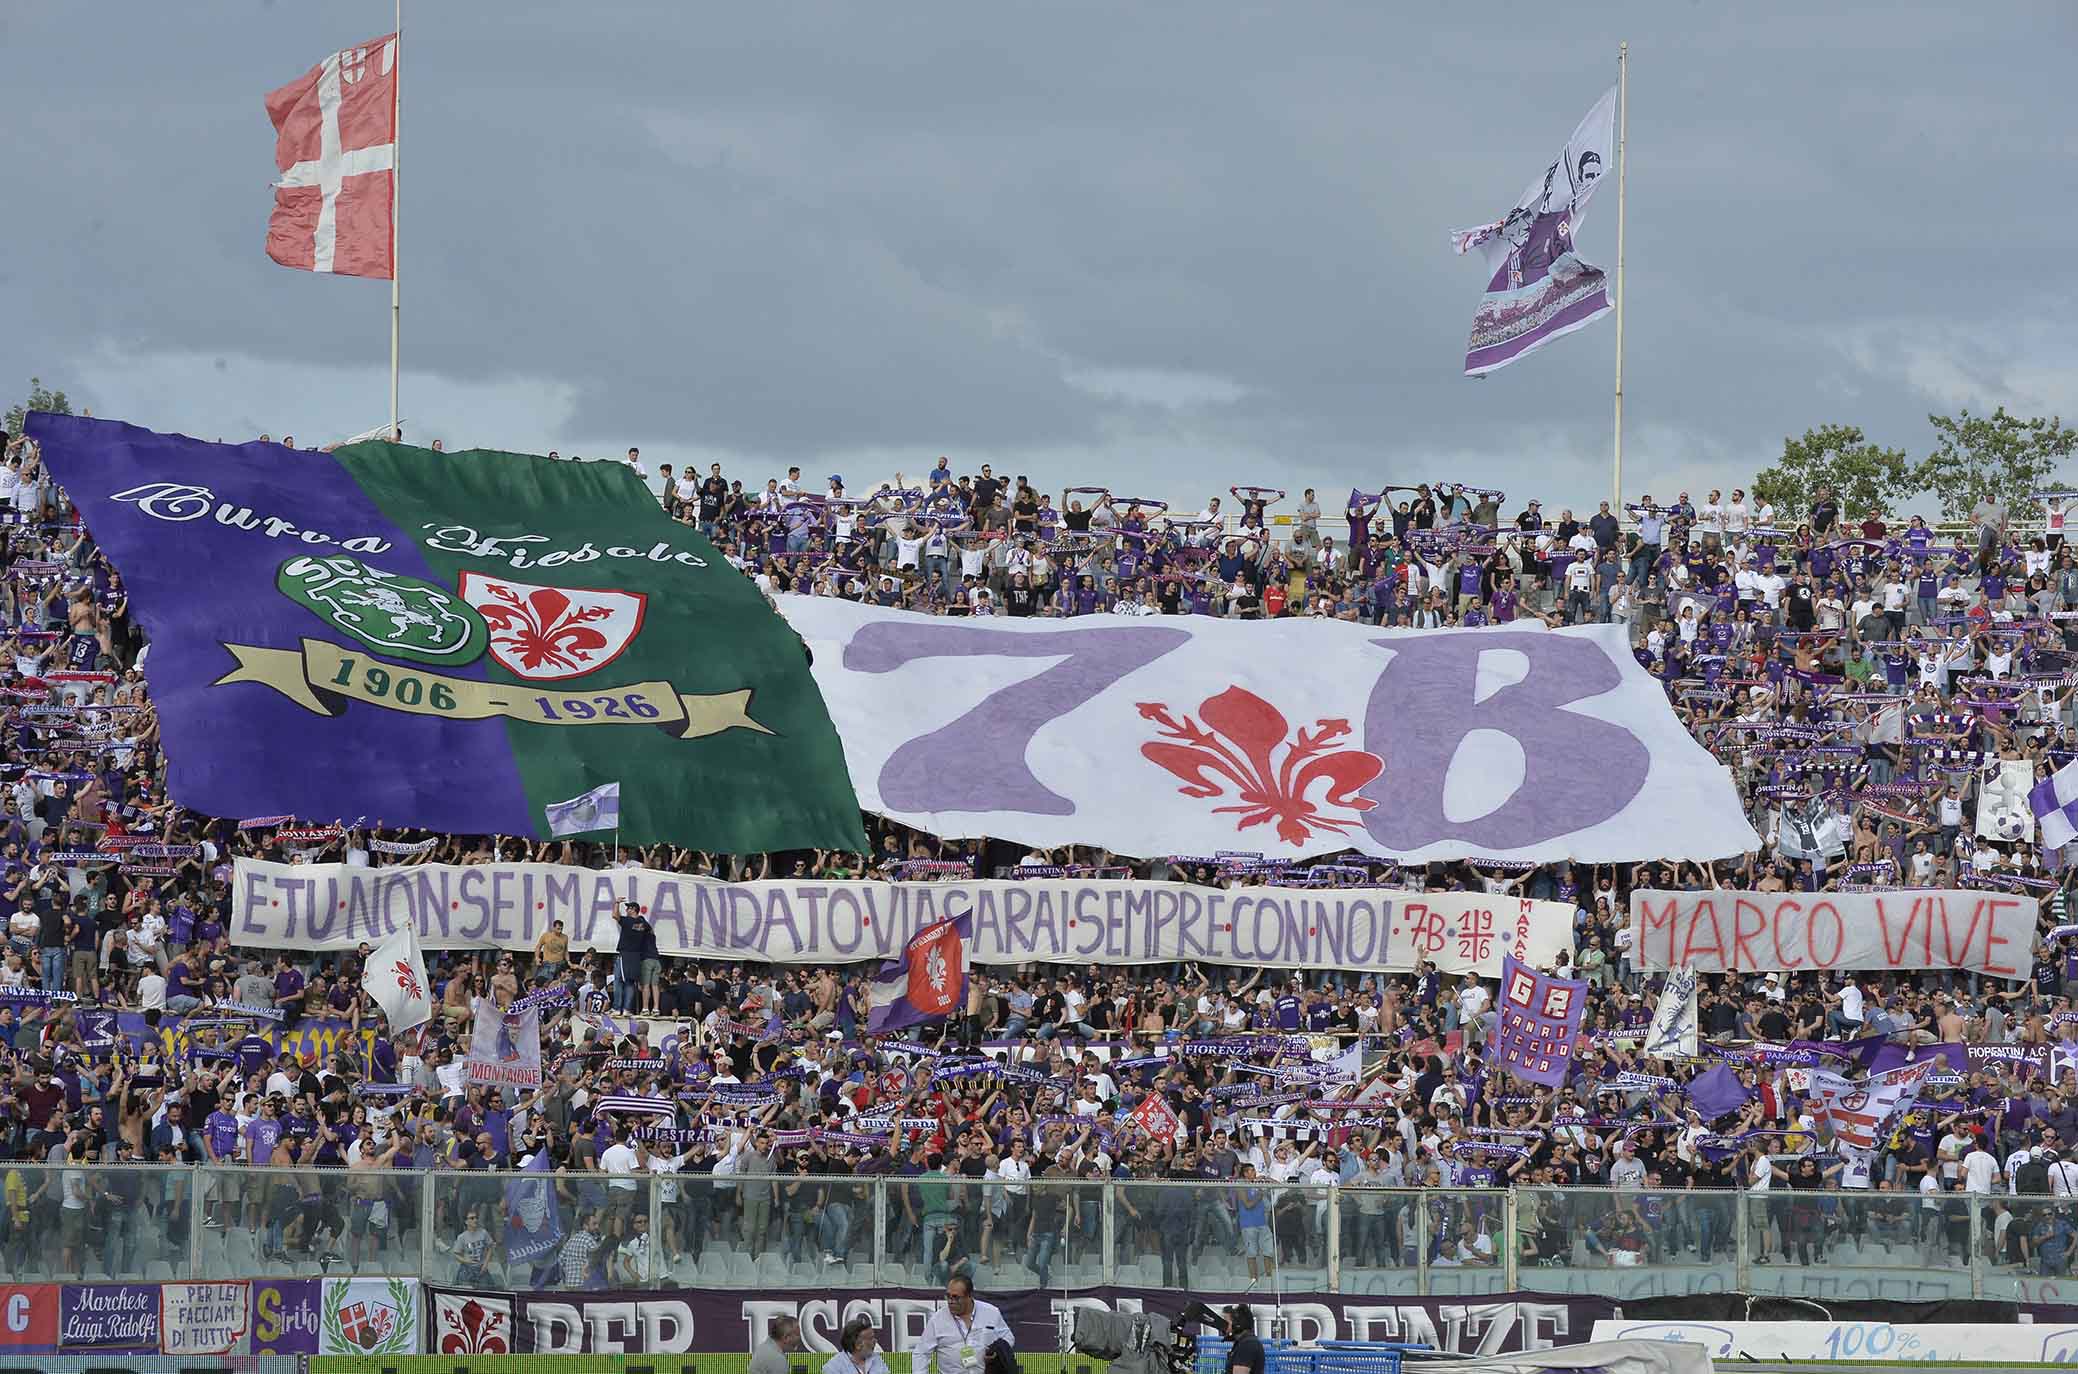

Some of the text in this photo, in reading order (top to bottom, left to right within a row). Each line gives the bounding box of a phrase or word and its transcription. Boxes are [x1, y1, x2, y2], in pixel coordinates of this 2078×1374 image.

[109, 481, 711, 570] Curva Fiesole
[330, 658, 457, 712] 1906
[534, 690, 660, 723] 1926
[842, 621, 1651, 850] 7 B
[1019, 866, 1066, 875] FIORENTINA
[275, 876, 346, 940] TU
[346, 871, 450, 941] NON
[459, 870, 534, 941] SEI
[648, 881, 864, 954] ANDATO
[1074, 888, 1225, 958] SEMPRE
[1231, 895, 1308, 963] CON
[1315, 899, 1393, 965] NOI
[1404, 903, 1446, 952] 7B
[1511, 900, 1534, 962] MARAS
[1638, 897, 2020, 975] MARCO VIVE
[611, 1059, 665, 1070] COLLETTIVO
[1765, 1051, 1812, 1062] PAMPERO
[72, 1287, 149, 1312] Marchese
[187, 1286, 212, 1303] PER
[218, 1286, 238, 1302] LEI
[7, 1293, 31, 1333] C
[63, 1313, 157, 1344] Luigi Ridolfi
[179, 1306, 236, 1324] FACCIAM
[172, 1327, 233, 1348] DI TUTTO
